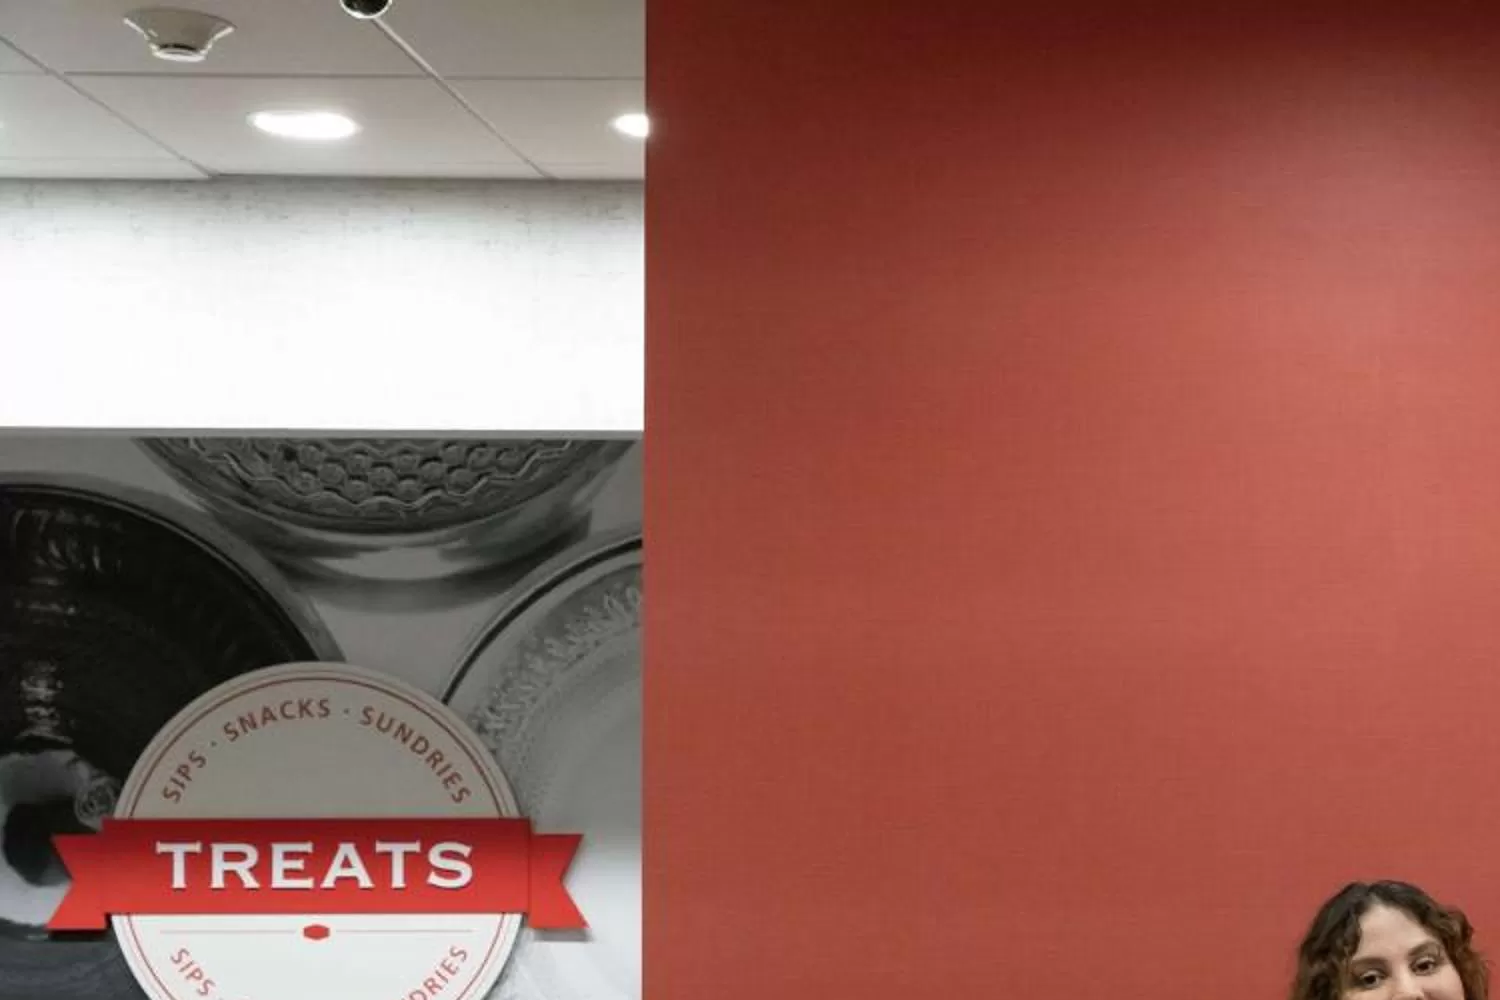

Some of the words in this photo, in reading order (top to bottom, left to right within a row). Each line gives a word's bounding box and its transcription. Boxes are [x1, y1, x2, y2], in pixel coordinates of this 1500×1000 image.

[163, 750, 207, 804] SIPS
[223, 698, 331, 743] SNACKS
[359, 706, 472, 804] SUNDRIES
[156, 841, 474, 890] TREATS
[170, 947, 216, 997] SIPS
